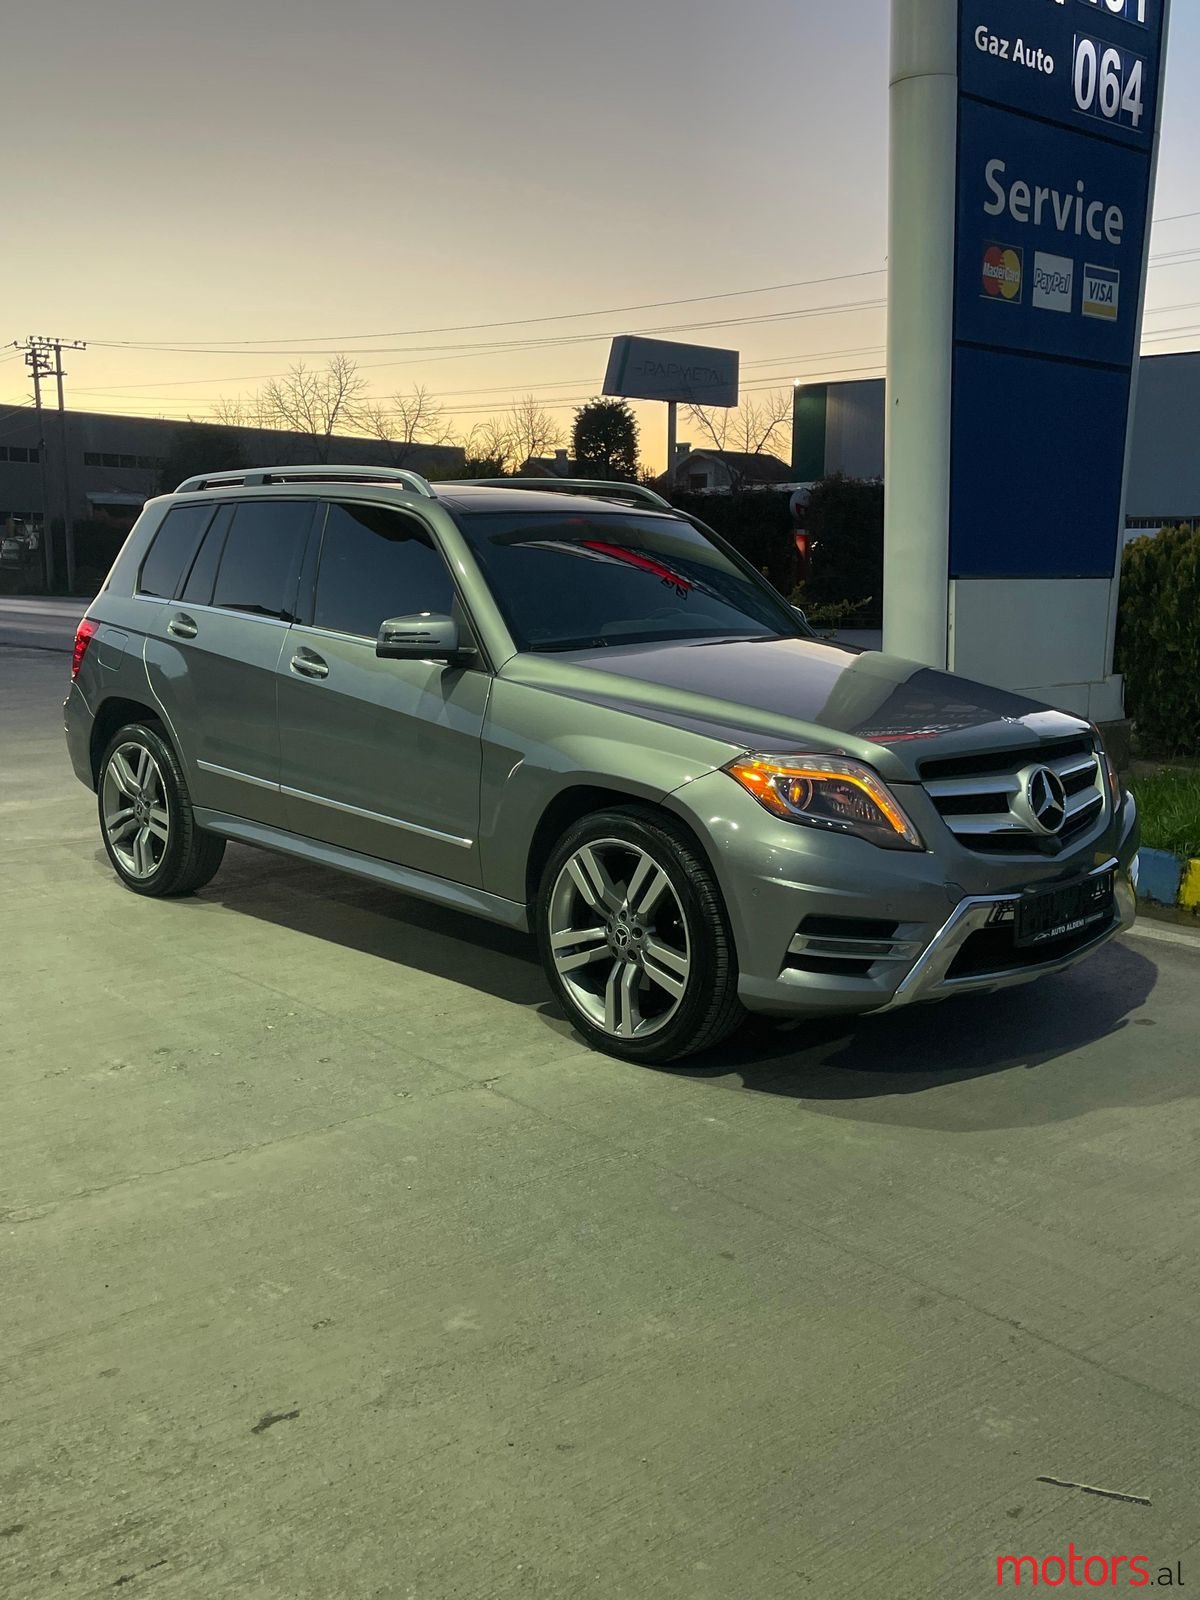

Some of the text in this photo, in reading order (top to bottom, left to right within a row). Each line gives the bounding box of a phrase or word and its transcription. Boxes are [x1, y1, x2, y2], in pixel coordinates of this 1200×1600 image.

[974, 25, 1055, 75] Gaz Auto
[1073, 38, 1144, 127] 064
[983, 158, 1124, 245] Service
[982, 261, 1020, 283] MasterCard
[1033, 268, 1071, 295] PayPal
[1089, 280, 1113, 304] VISA
[1051, 925, 1066, 937] AUTO
